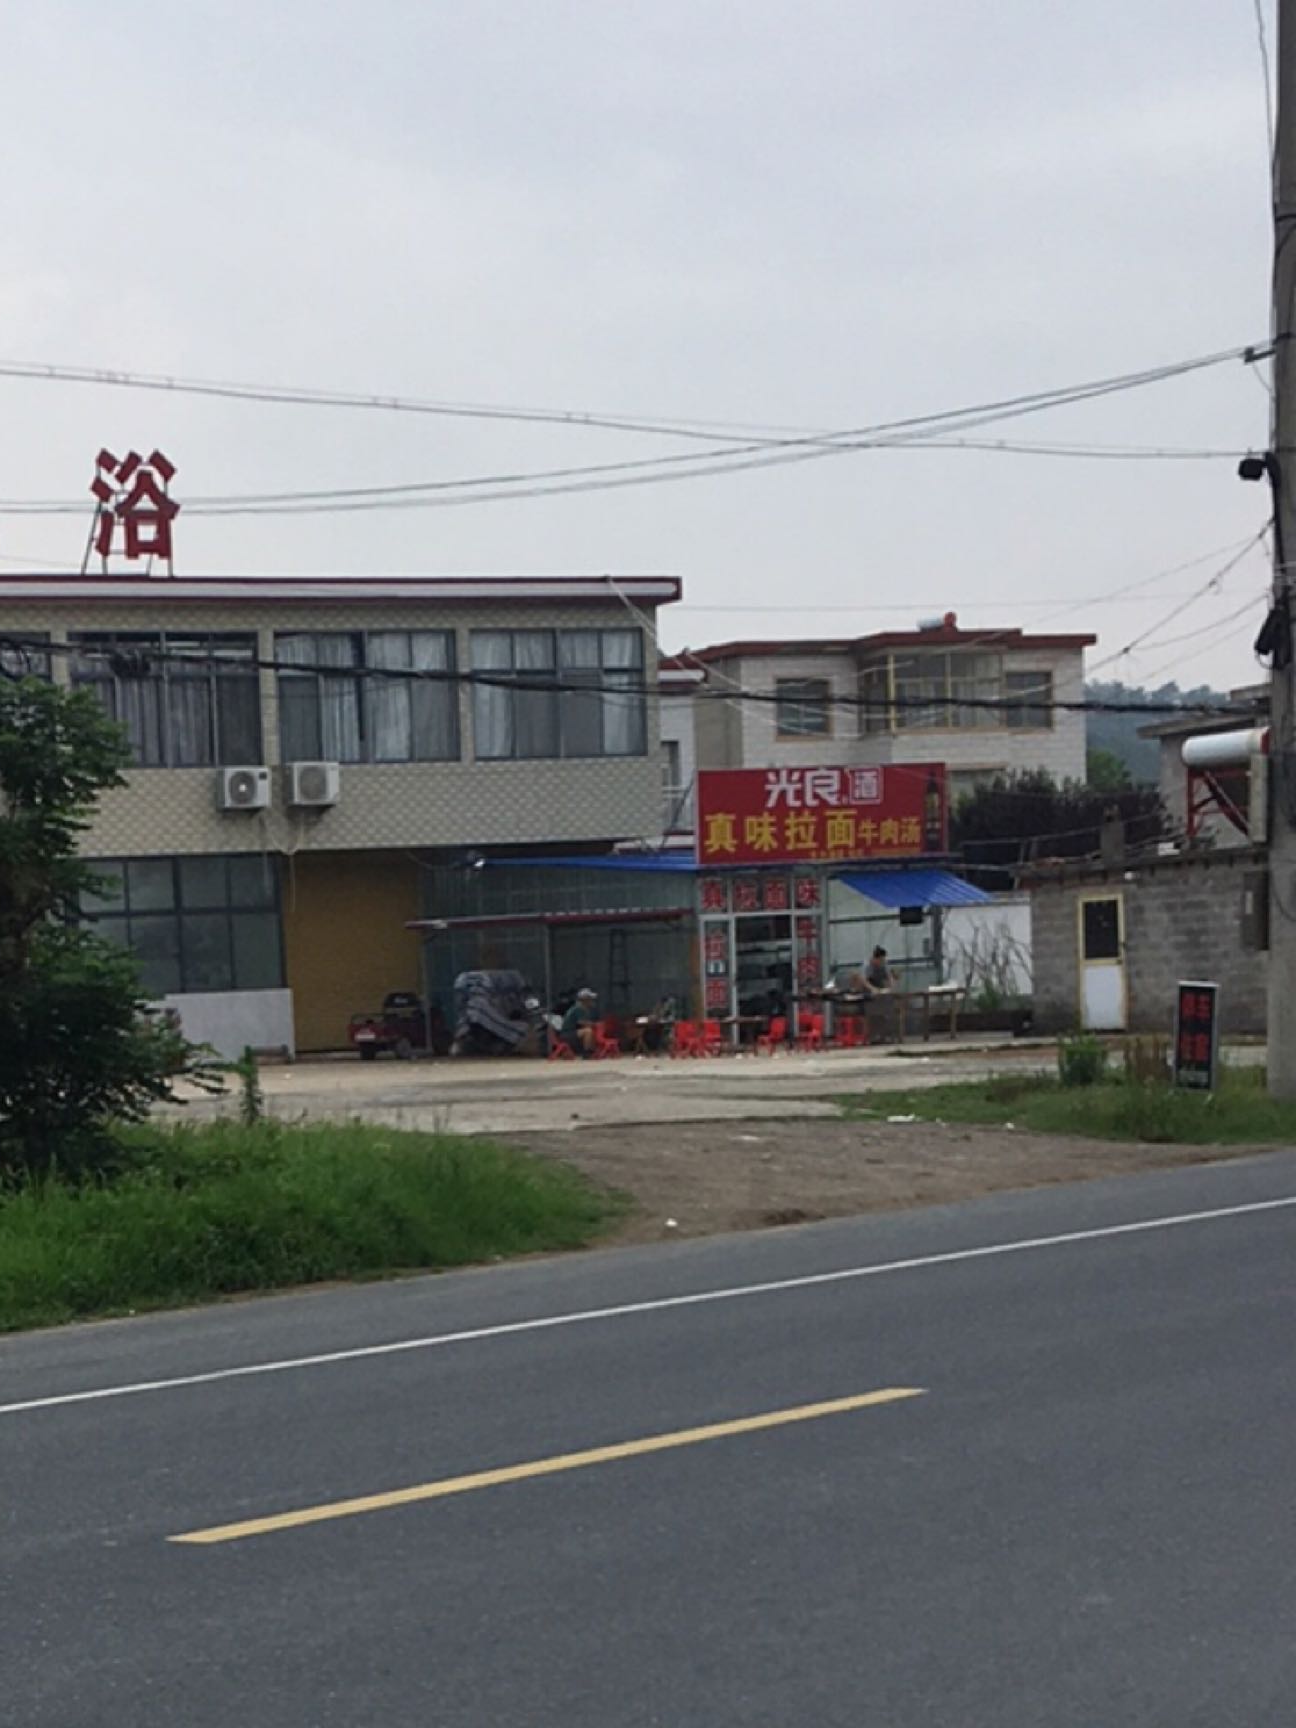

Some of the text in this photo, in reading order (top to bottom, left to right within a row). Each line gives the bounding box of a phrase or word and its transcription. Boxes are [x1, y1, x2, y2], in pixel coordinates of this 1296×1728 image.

[704, 808, 921, 854] 真味拉面 牛肉汤
